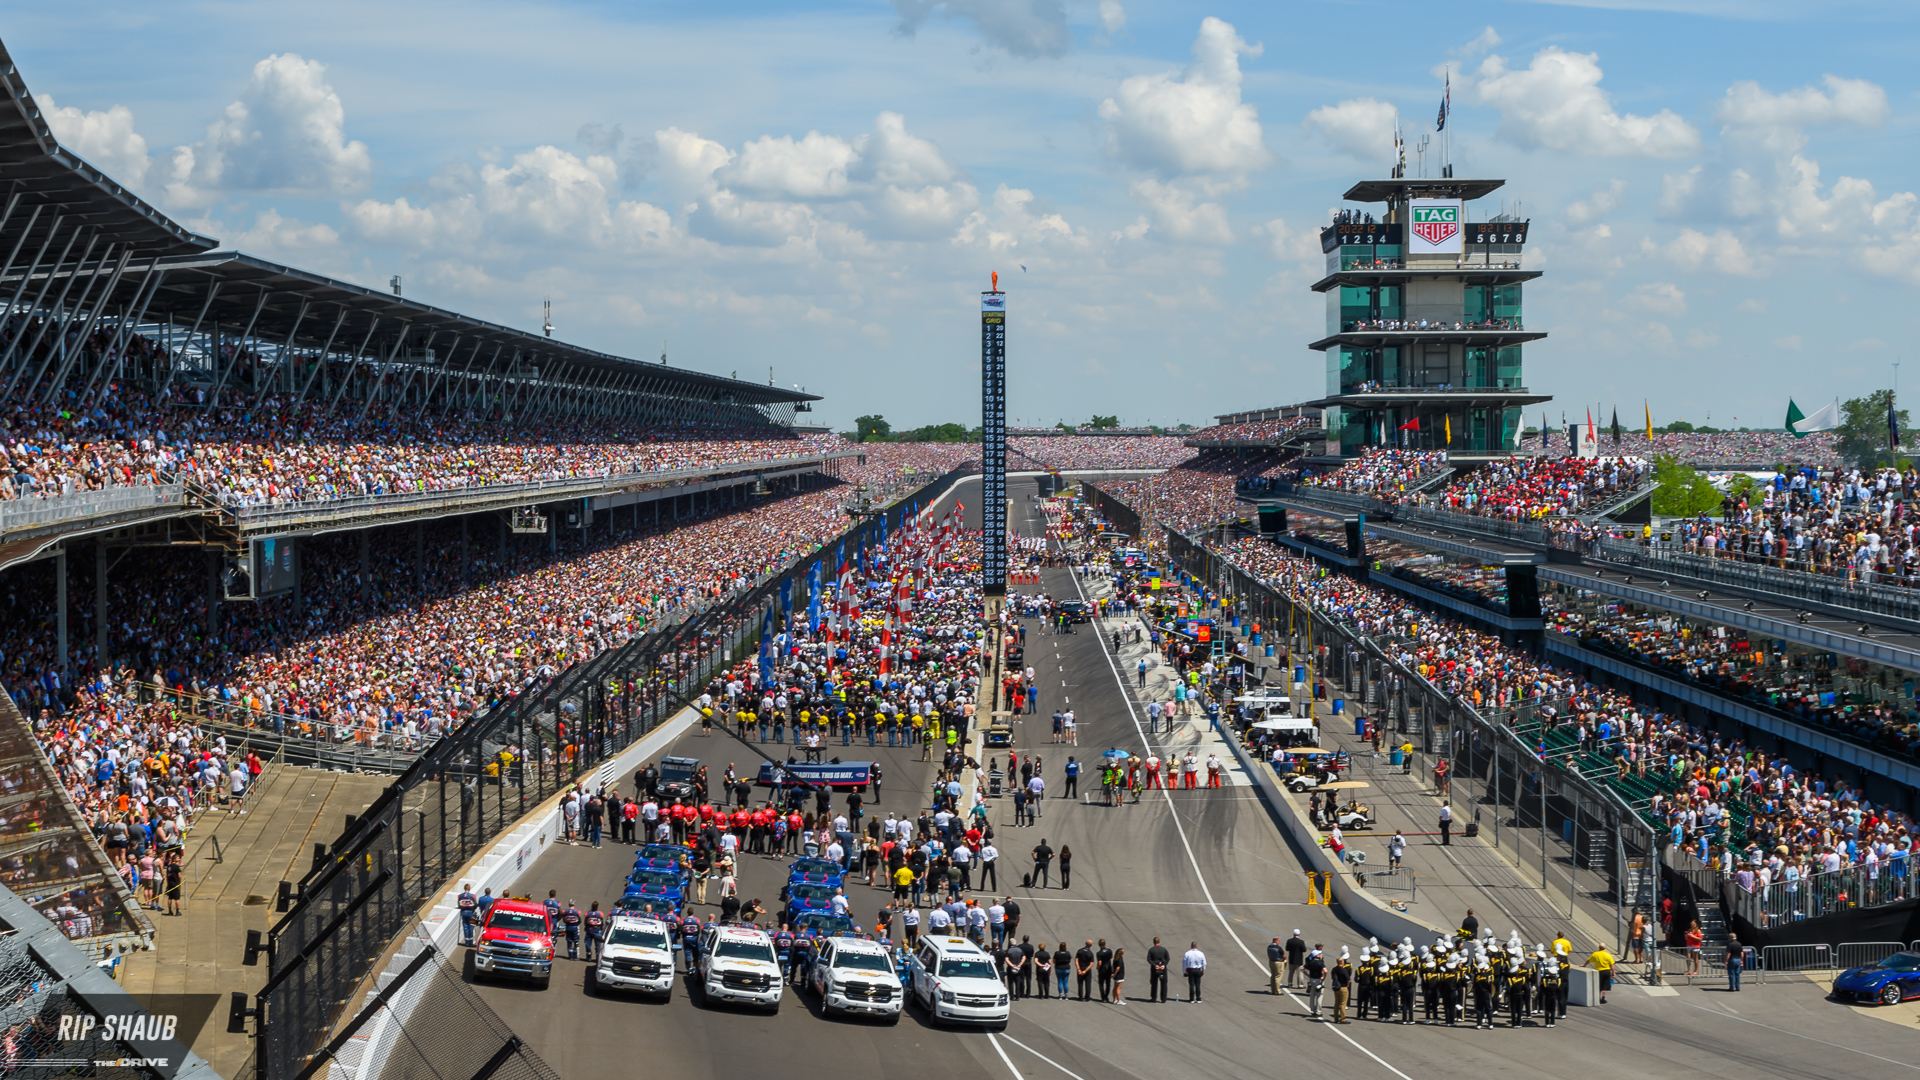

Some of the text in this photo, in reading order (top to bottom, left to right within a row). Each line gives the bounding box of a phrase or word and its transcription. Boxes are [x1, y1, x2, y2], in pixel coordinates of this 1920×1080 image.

[1417, 209, 1454, 221] TAG
[1416, 223, 1456, 241] HEUER
[1342, 235, 1386, 244] 1 2 3 4
[1476, 234, 1522, 243] 5 6 7 8
[986, 364, 991, 372] 6
[986, 372, 991, 380] 7
[986, 435, 994, 443] 15
[986, 443, 994, 451] 16
[985, 506, 994, 514] 24
[985, 514, 994, 522] 25
[1234, 666, 1242, 674] 21
[494, 909, 544, 920] CHEVROLET
[614, 926, 664, 936] CHEVROLET
[720, 938, 770, 948] CHEVROLET
[837, 948, 884, 956] CHEVROLET
